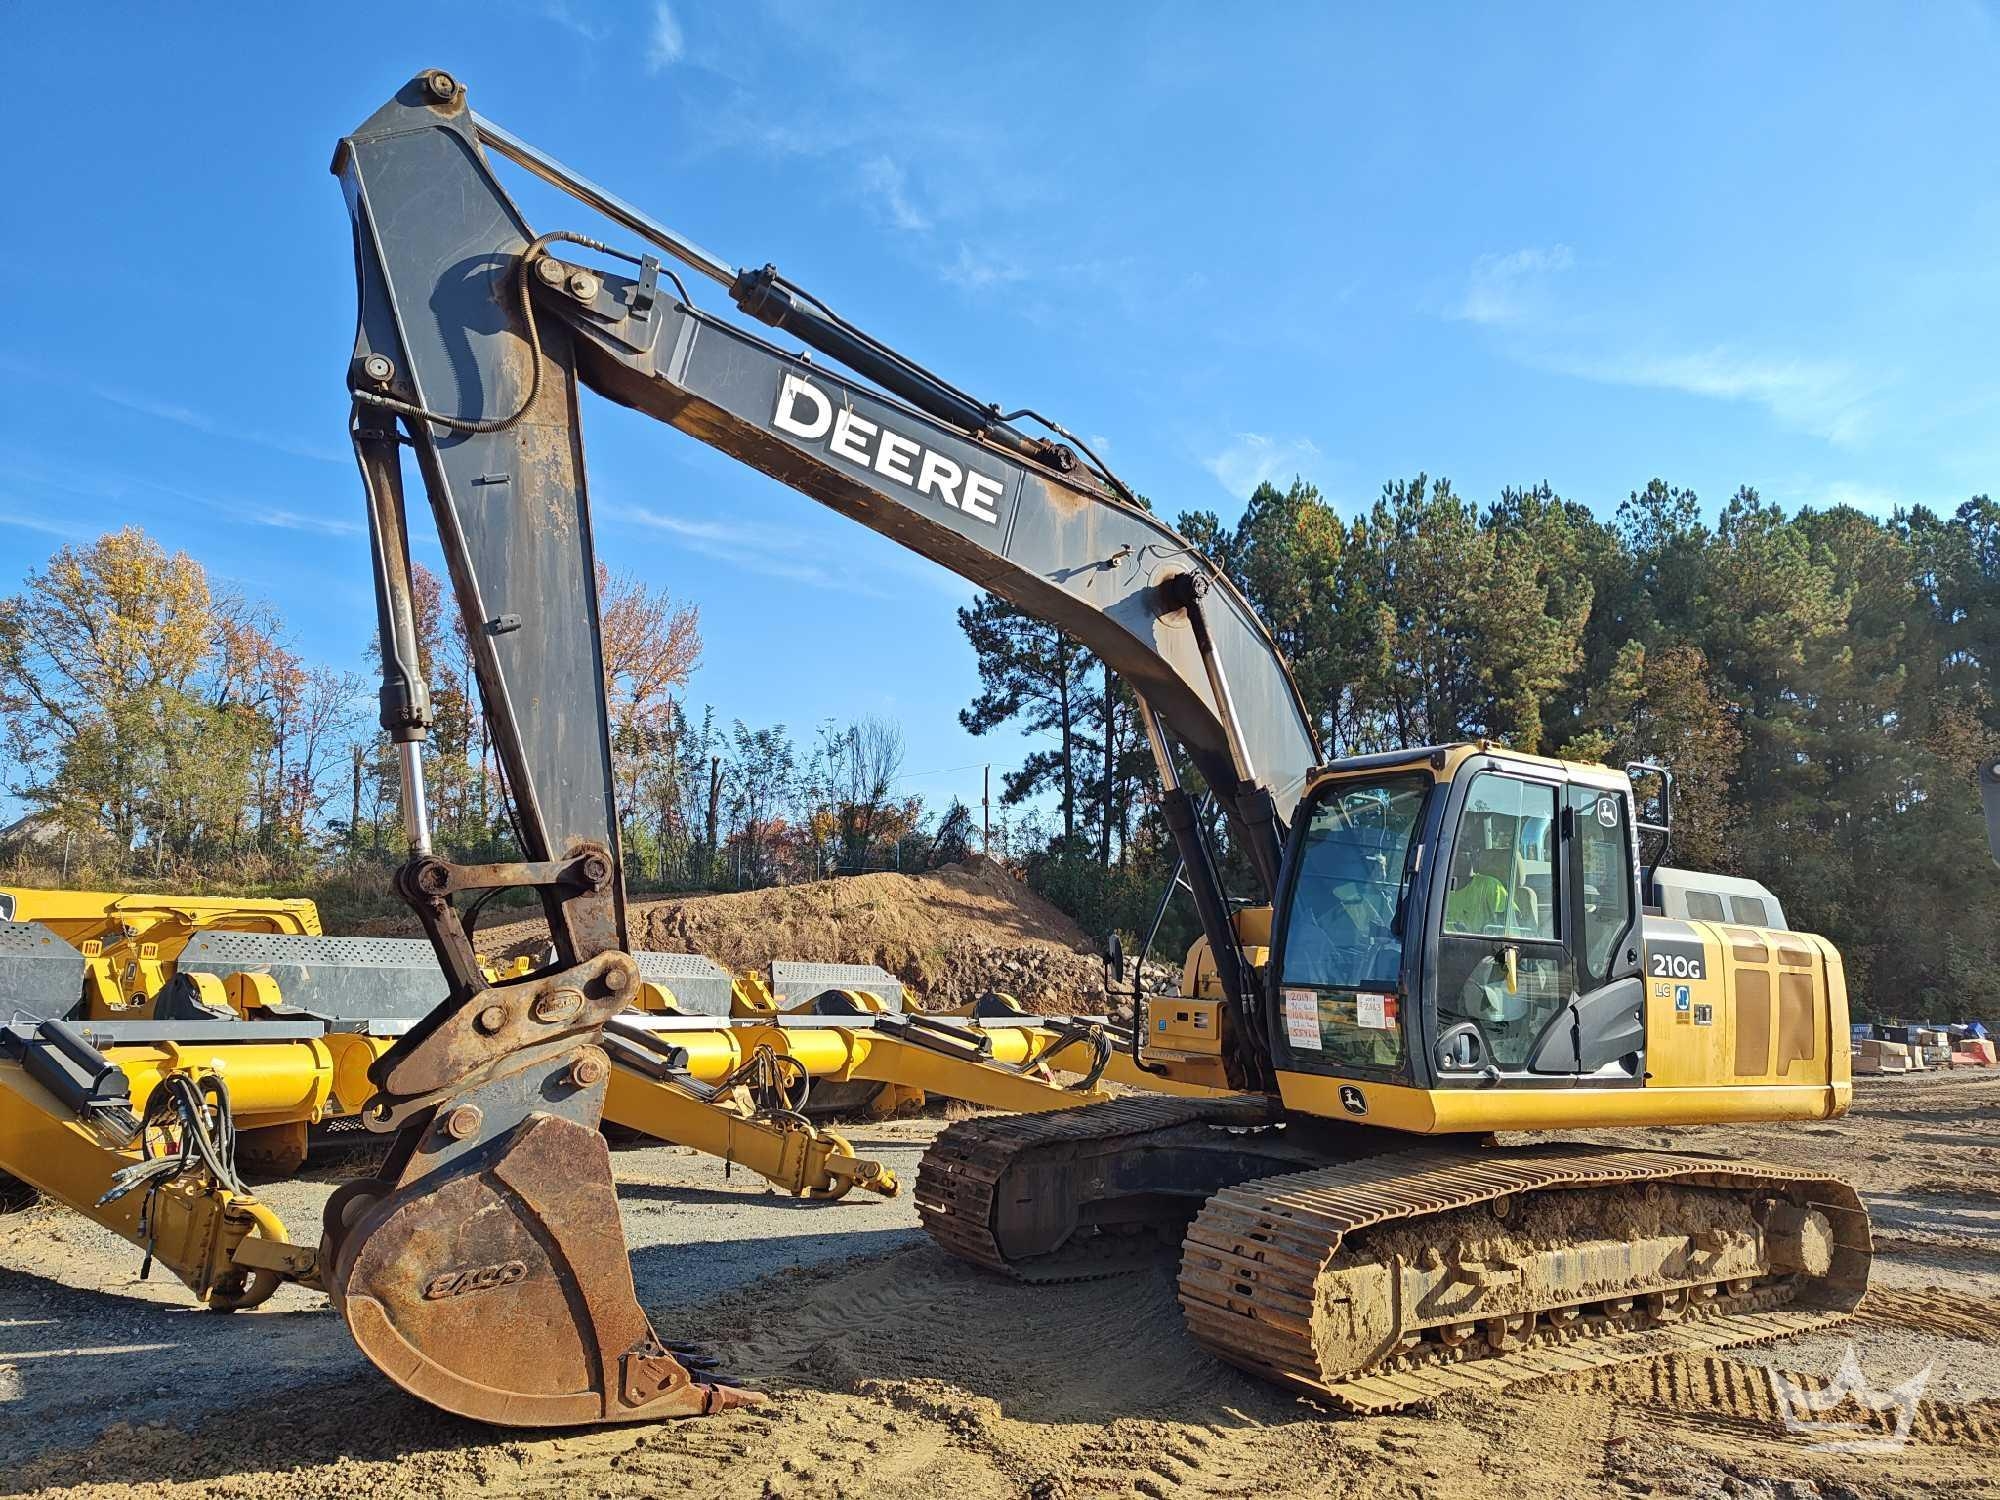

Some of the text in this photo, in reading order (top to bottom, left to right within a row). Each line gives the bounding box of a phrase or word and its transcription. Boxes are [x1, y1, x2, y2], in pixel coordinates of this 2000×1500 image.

[774, 373, 1003, 525] DEERE
[1652, 953, 1701, 979] 210G
[1655, 983, 1671, 998] LC
